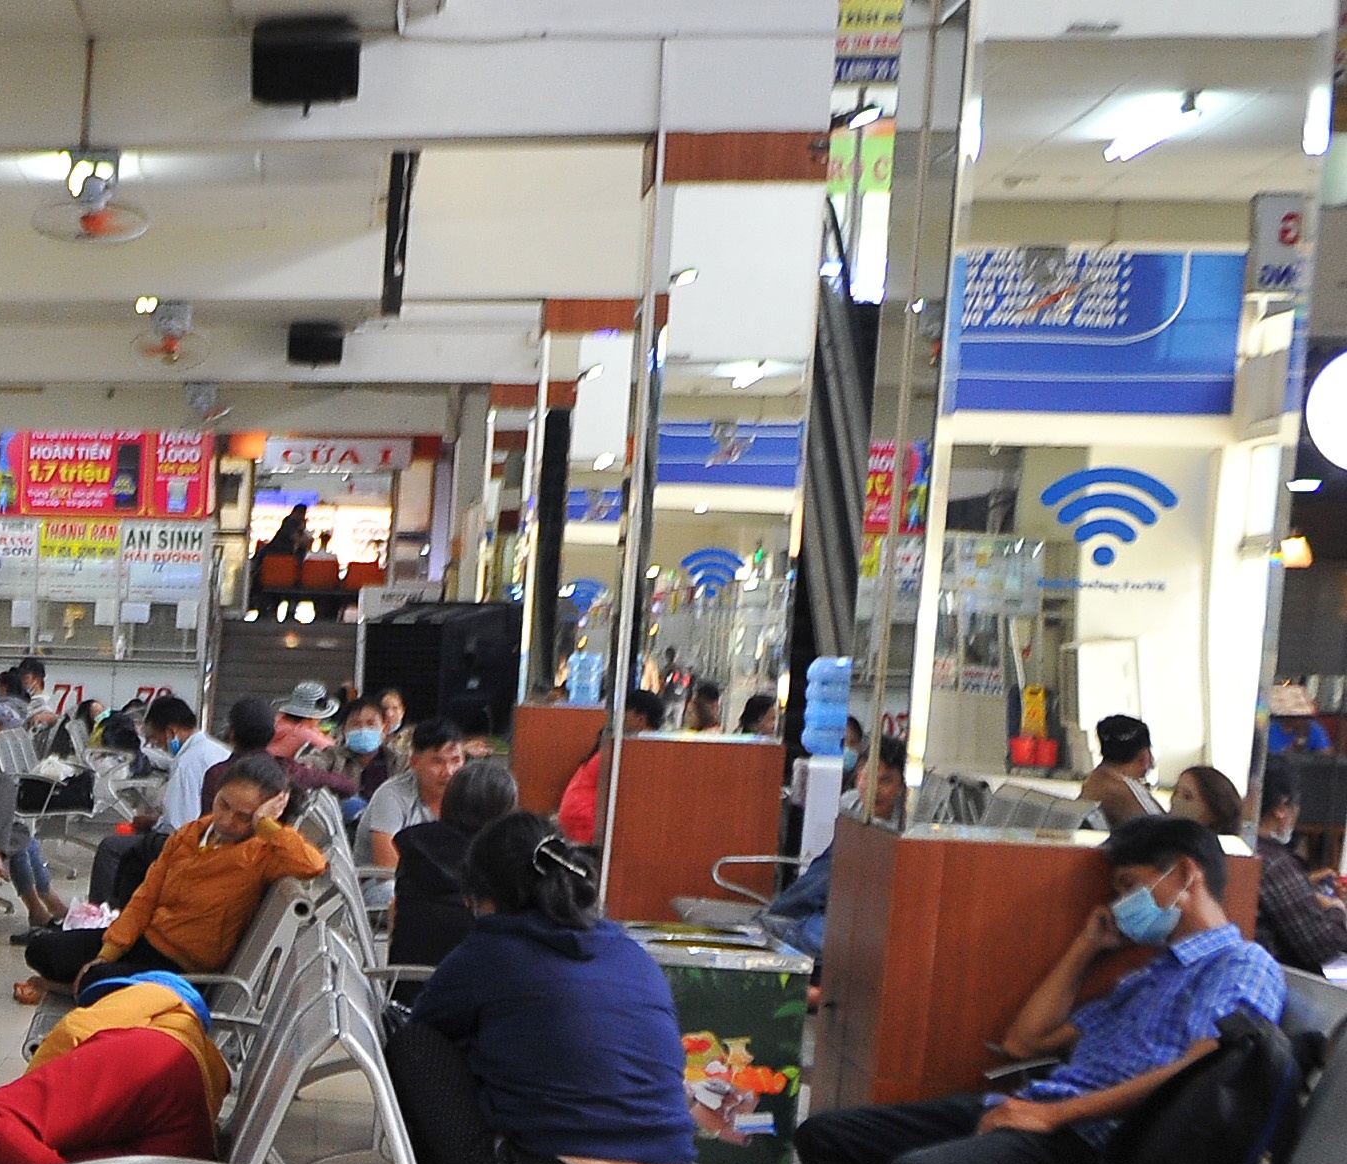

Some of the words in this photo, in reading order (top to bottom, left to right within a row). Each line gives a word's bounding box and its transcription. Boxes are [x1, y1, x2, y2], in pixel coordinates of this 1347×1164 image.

[156, 446, 201, 464] 1.000
[28, 462, 57, 483] 1.7
[58, 461, 112, 488] triệu
[125, 528, 151, 551] AN
[157, 529, 203, 551] SINH
[54, 684, 84, 715] 71
